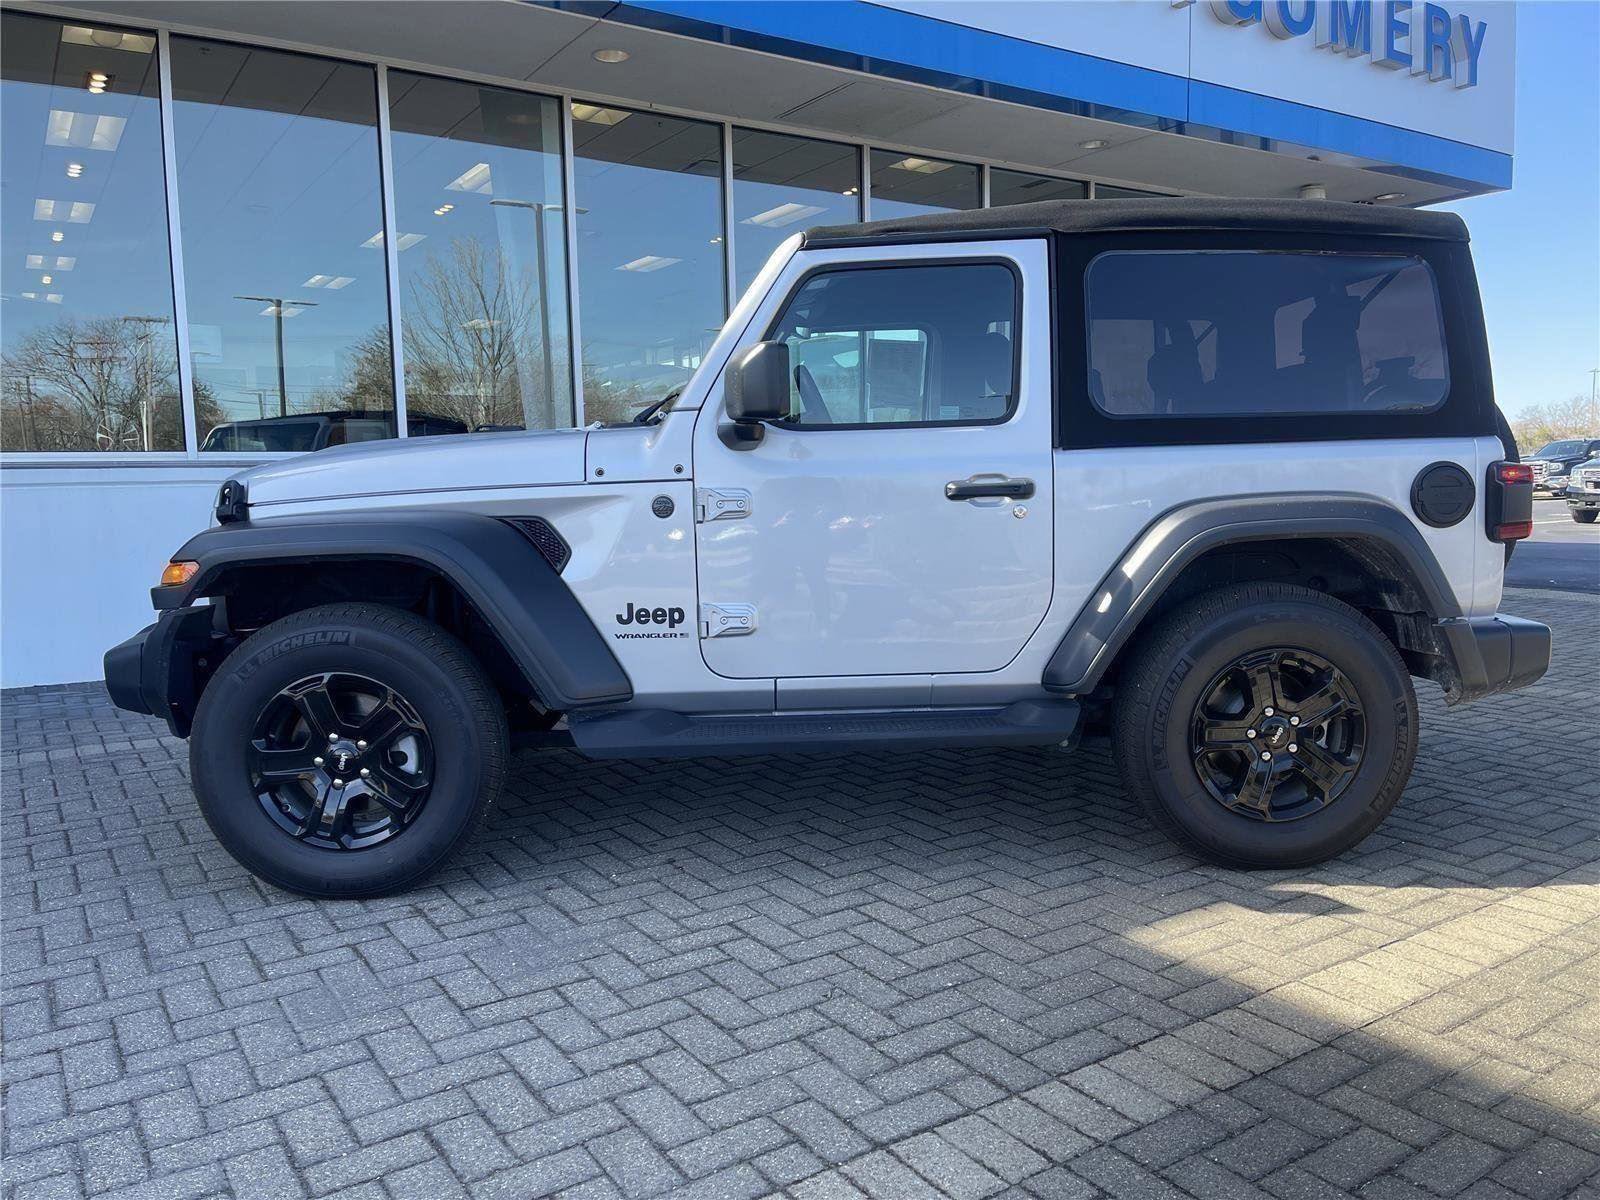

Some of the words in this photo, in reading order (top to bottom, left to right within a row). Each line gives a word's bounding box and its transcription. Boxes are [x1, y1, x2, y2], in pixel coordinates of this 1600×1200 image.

[615, 602, 685, 629] Jeep
[614, 632, 678, 640] WRANGLER
[257, 630, 350, 664] MICHELIN
[1271, 727, 1284, 744] Jeep
[338, 752, 348, 771] Jeep
